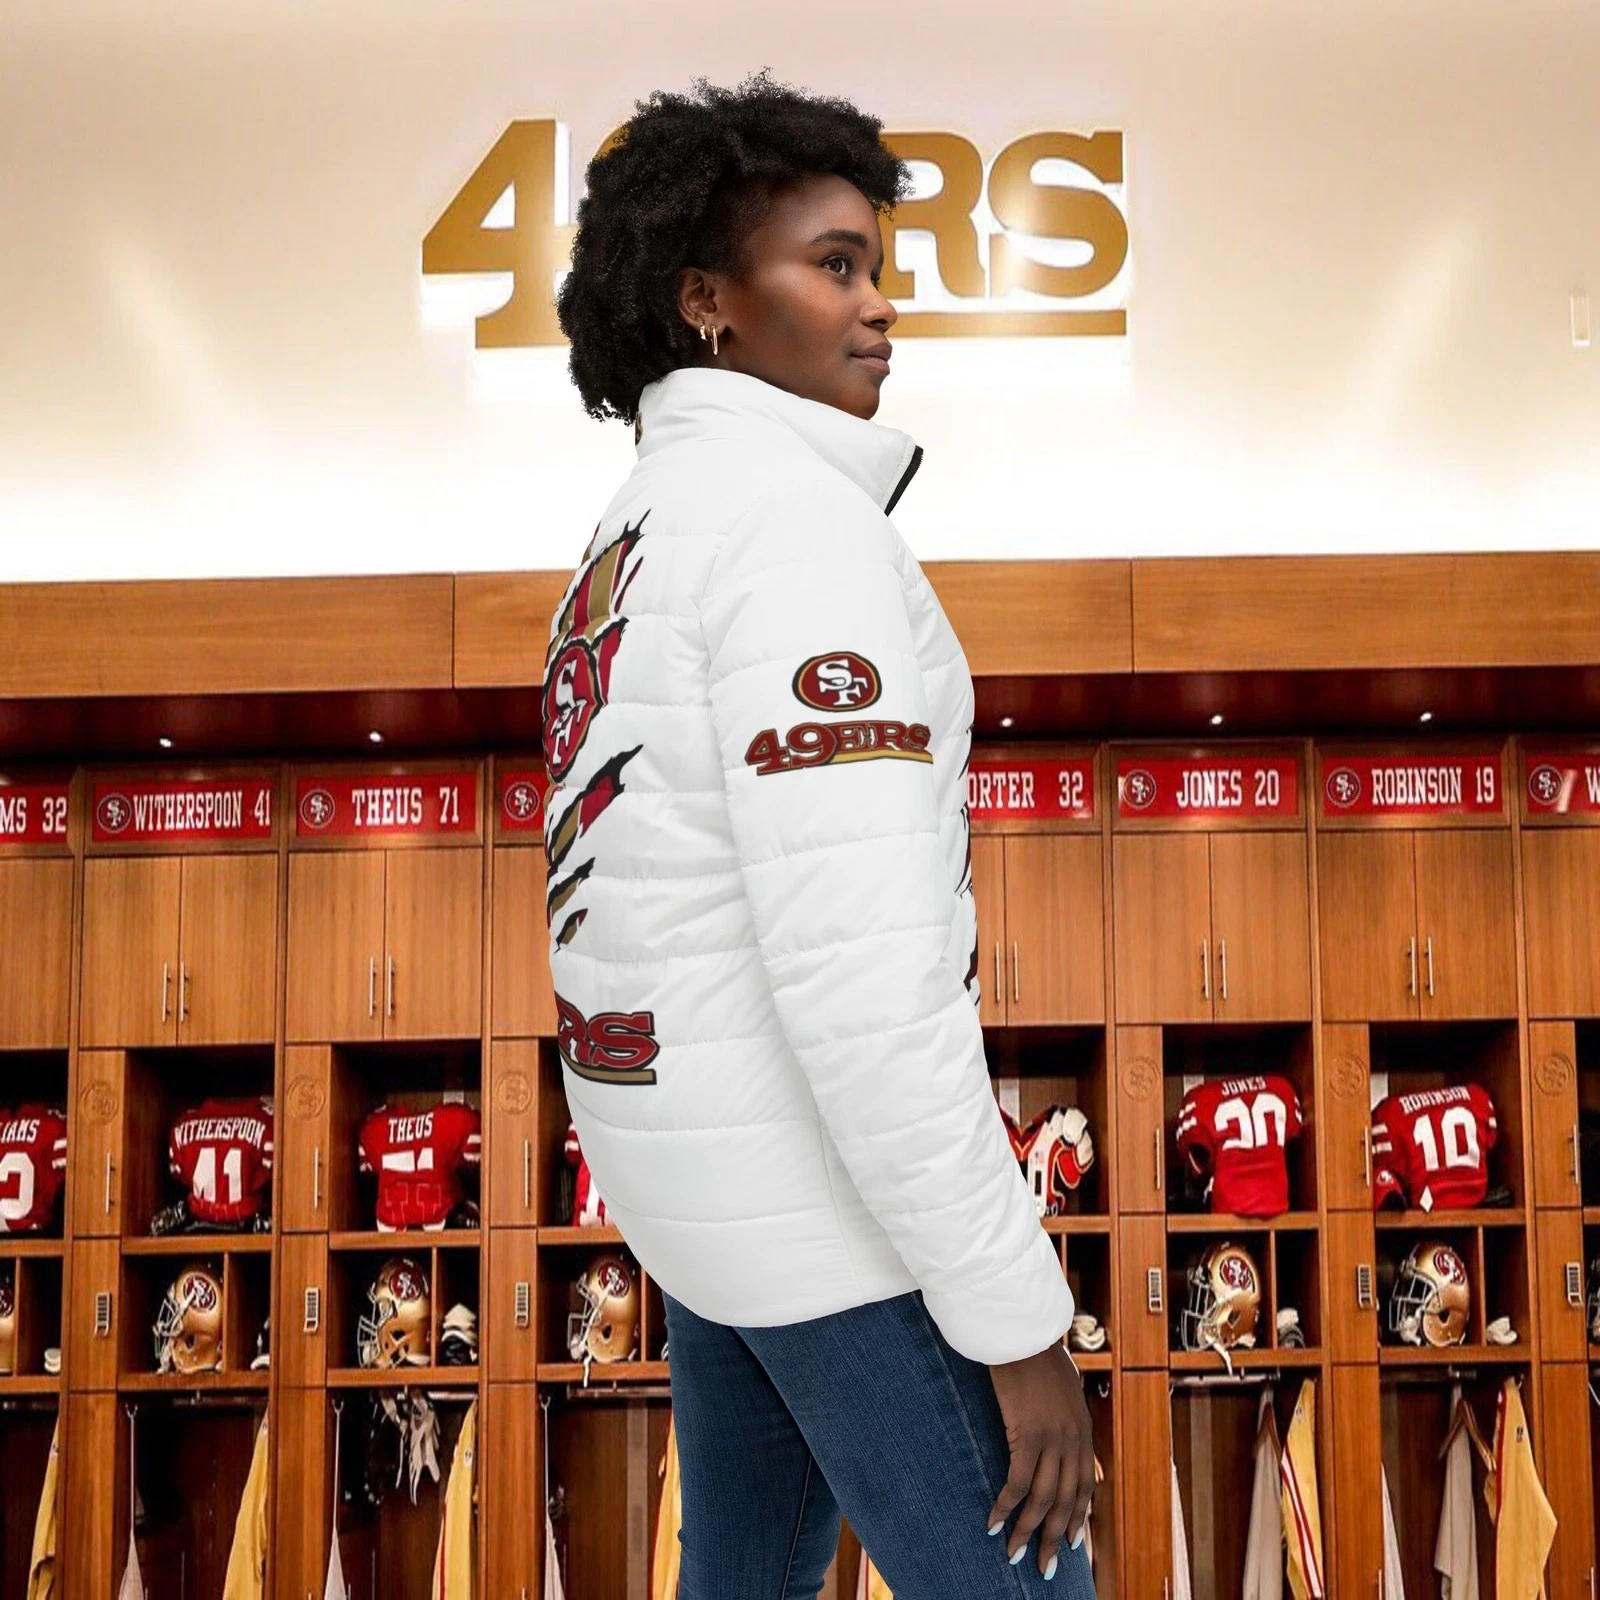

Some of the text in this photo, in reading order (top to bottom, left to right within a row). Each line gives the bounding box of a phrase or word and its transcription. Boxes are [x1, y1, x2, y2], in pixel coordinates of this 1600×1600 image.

[816, 659, 869, 706] SF
[967, 771, 1083, 809] ORTER 32
[1176, 769, 1280, 808] JONES 20
[1371, 766, 1495, 806] ROBINSON 19
[42, 797, 67, 834] 32
[133, 790, 271, 831] WITHERSPOON 41
[352, 786, 460, 826] THEUS 71
[1221, 1076, 1267, 1096] JONES
[1399, 1086, 1471, 1115] ROBINSON
[173, 1117, 266, 1149] WITHERSPOON
[388, 1112, 434, 1144] THEUS
[192, 1147, 242, 1204] 41
